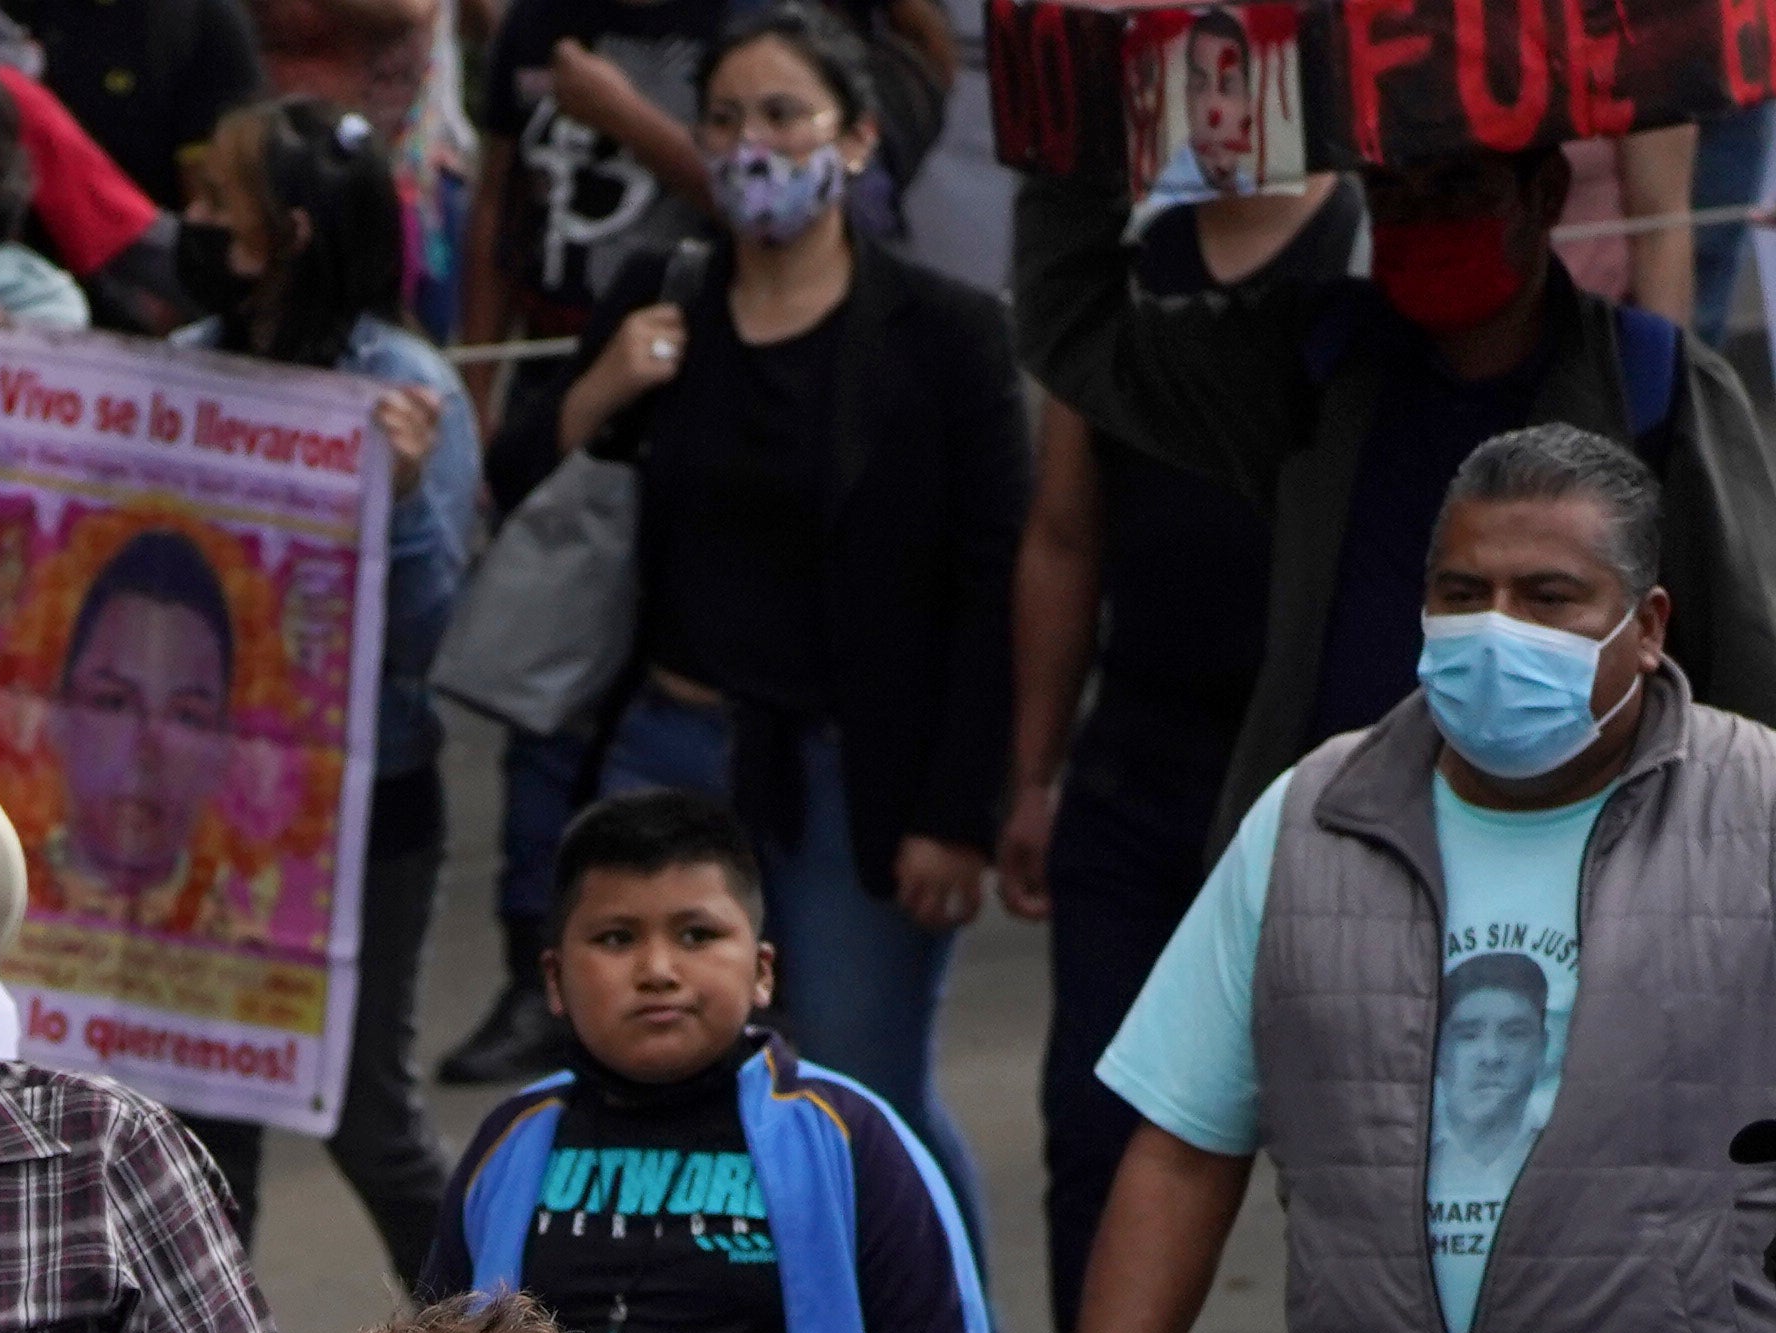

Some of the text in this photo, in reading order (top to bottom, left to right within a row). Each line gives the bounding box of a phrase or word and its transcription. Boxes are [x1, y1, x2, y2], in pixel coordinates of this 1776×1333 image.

[1342, 0, 1637, 164] FUE
[95, 396, 139, 436] se
[149, 392, 183, 443] lo
[1487, 921, 1529, 949] SIN
[28, 997, 296, 1086] lo queremos!
[1429, 1234, 1485, 1256] HEZ
